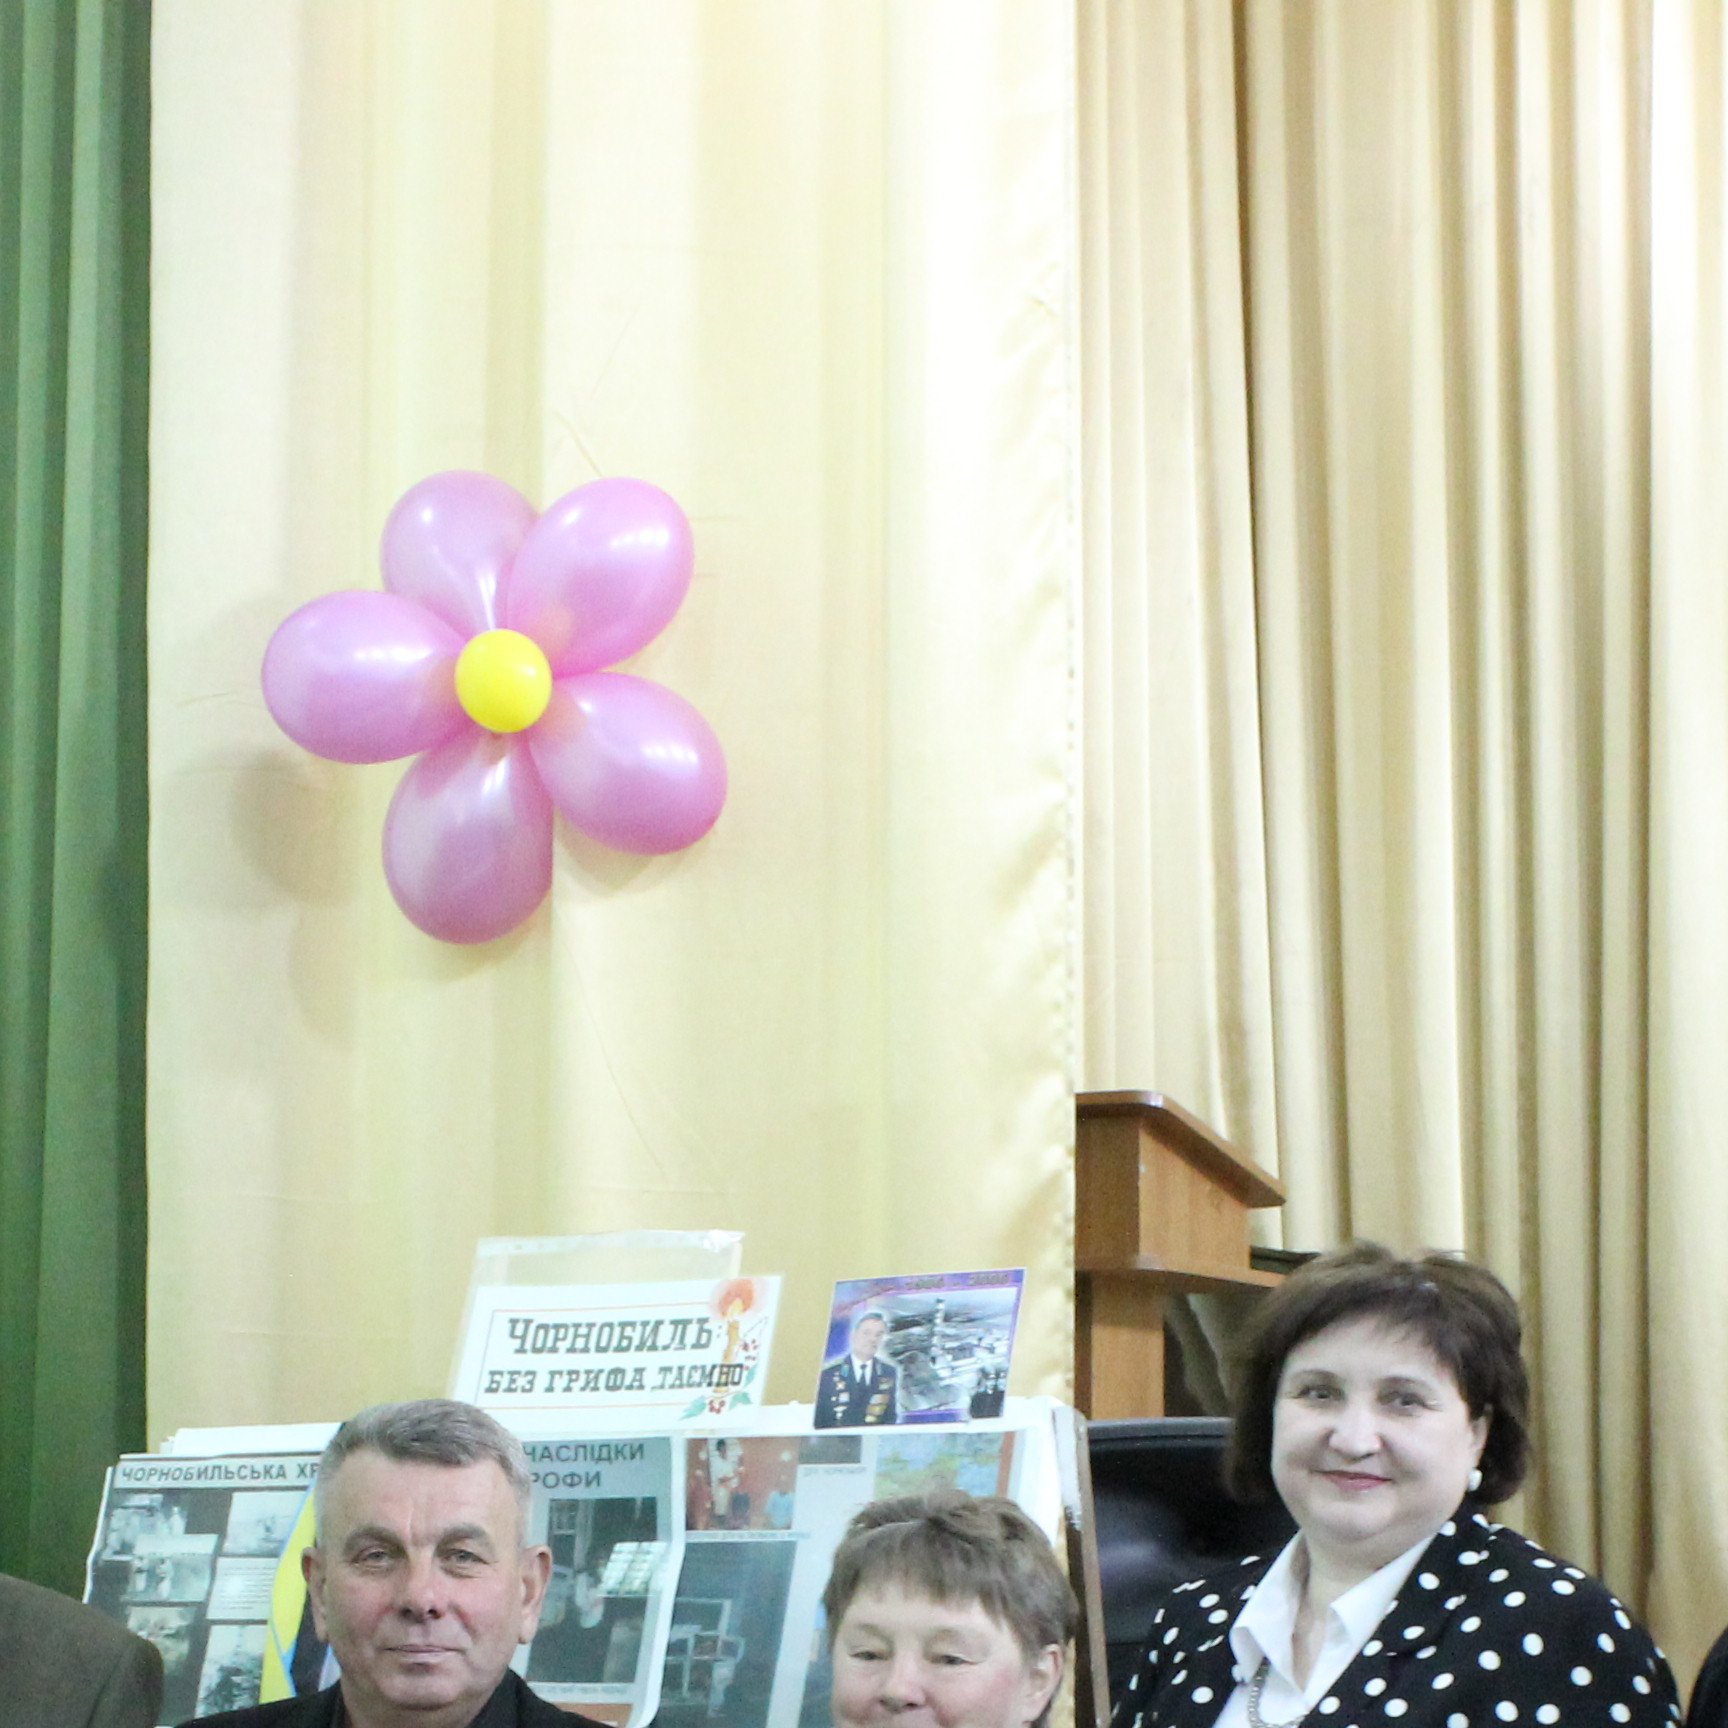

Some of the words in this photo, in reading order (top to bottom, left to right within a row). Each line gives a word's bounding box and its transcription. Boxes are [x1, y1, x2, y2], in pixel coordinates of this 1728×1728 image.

[508, 1317, 713, 1355] ЧОРНОБИЛЬ
[483, 1369, 538, 1394] БЕЗ
[543, 1366, 647, 1393] ГРИФА
[121, 1462, 288, 1483] ЧОРНОБИЛЬСЬКА
